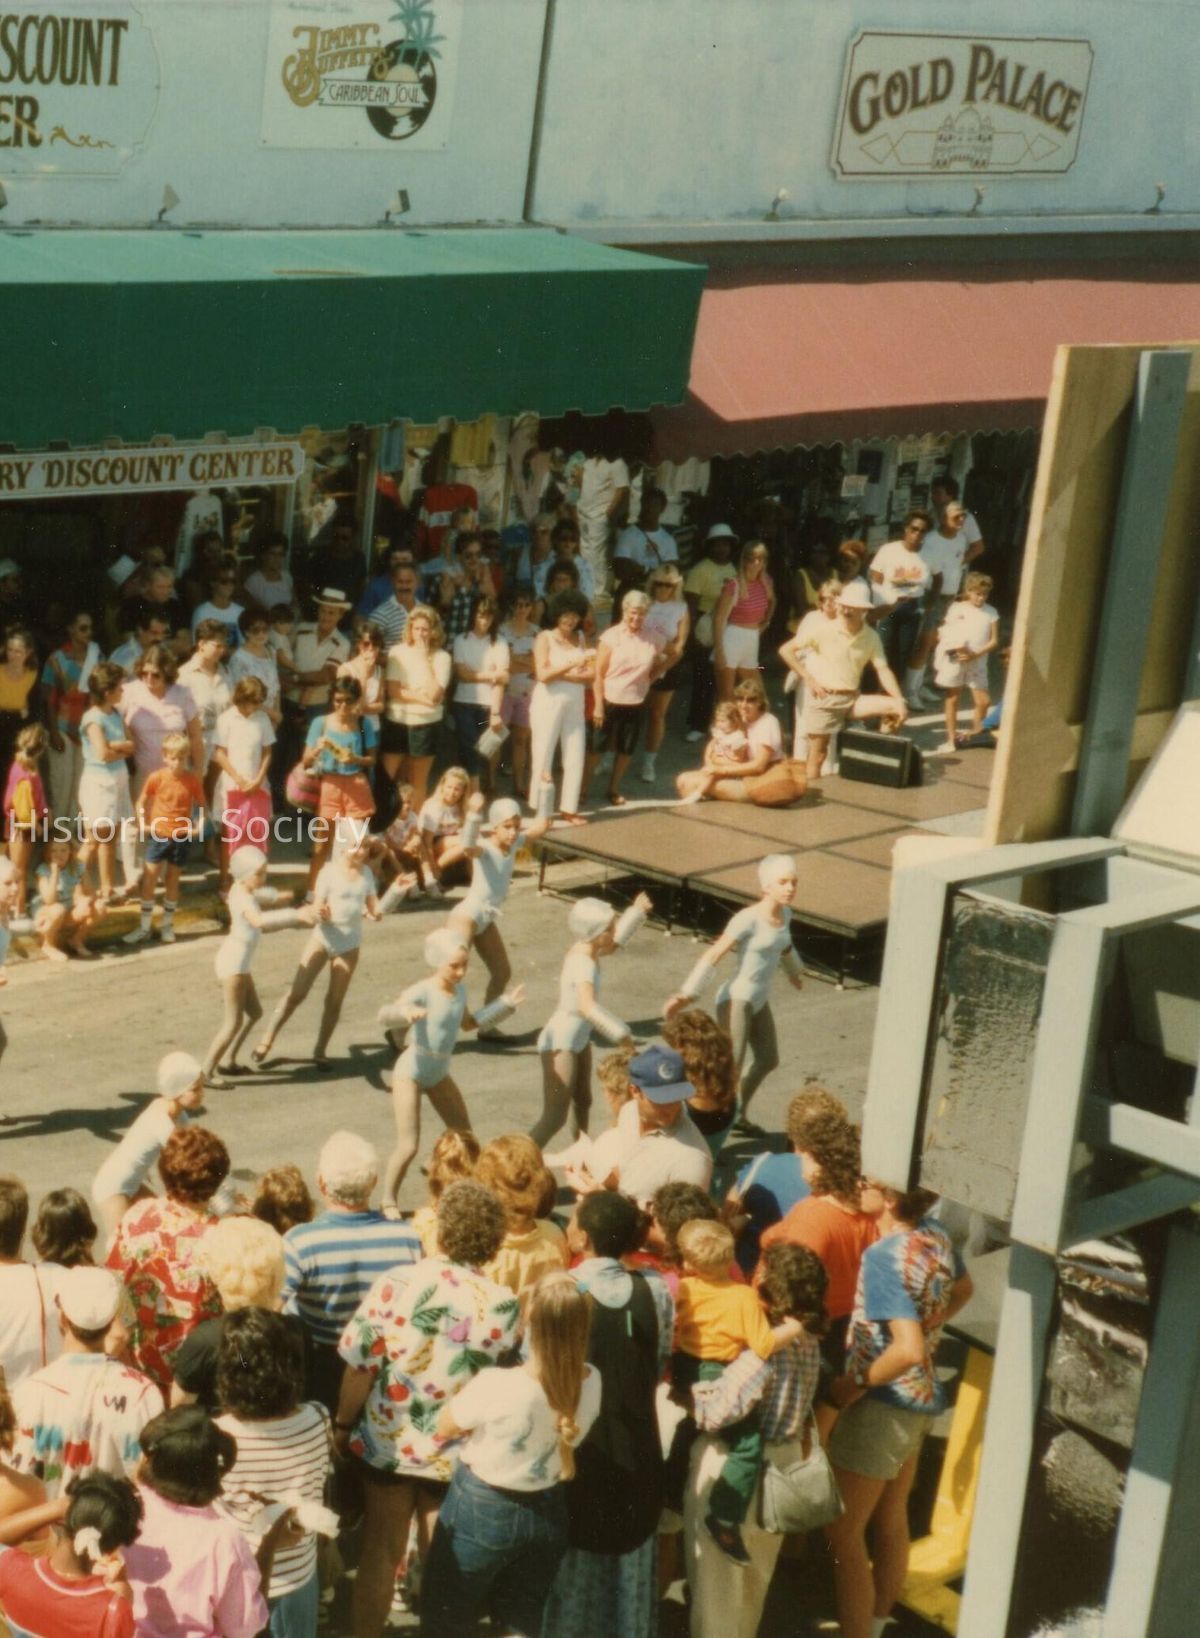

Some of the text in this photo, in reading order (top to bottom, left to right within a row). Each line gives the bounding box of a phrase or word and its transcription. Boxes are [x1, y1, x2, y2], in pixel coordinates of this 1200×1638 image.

[329, 83, 420, 105] CARIBBEAN SOUL
[849, 43, 1082, 135] GOLD PALACE
[41, 453, 182, 489] DISCOUNT
[189, 448, 296, 482] CENTER
